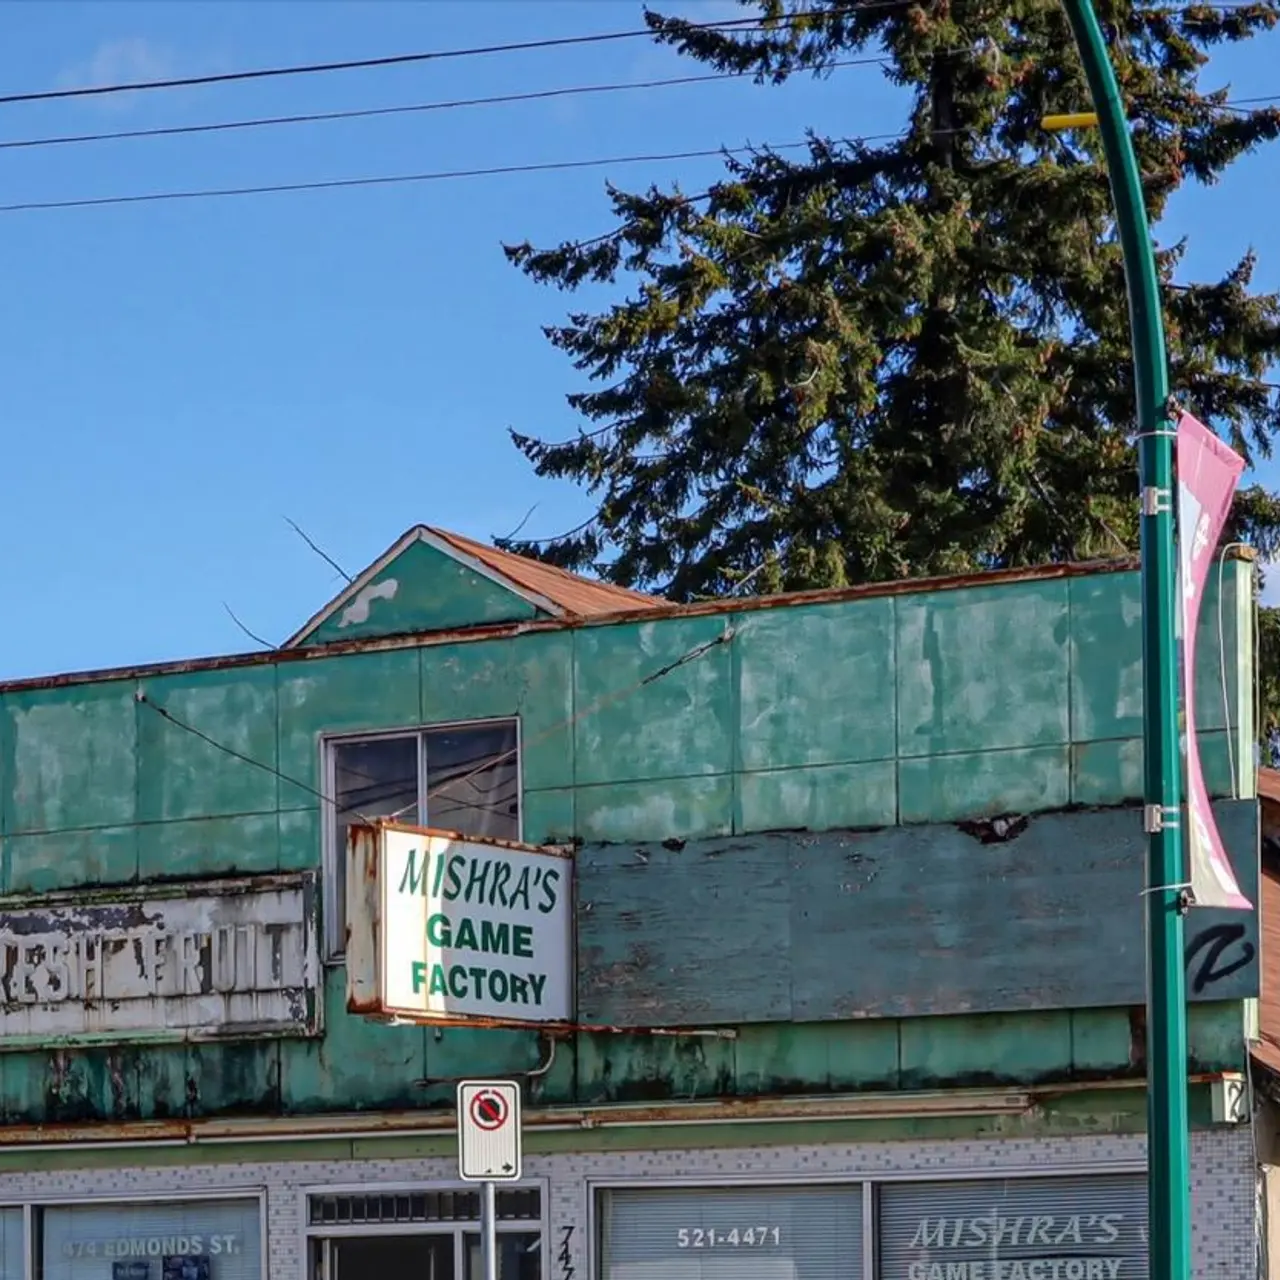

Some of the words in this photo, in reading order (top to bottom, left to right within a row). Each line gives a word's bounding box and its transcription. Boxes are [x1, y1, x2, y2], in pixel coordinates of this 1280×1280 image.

[399, 848, 560, 914] MISHRA'S
[426, 913, 534, 959] GAME
[411, 960, 547, 1006] FACTORY
[104, 1235, 203, 1257] EDMONDS
[210, 1233, 240, 1255] ST.
[677, 1226, 780, 1248] 521-4471
[909, 1213, 1124, 1249] MISHRA'S
